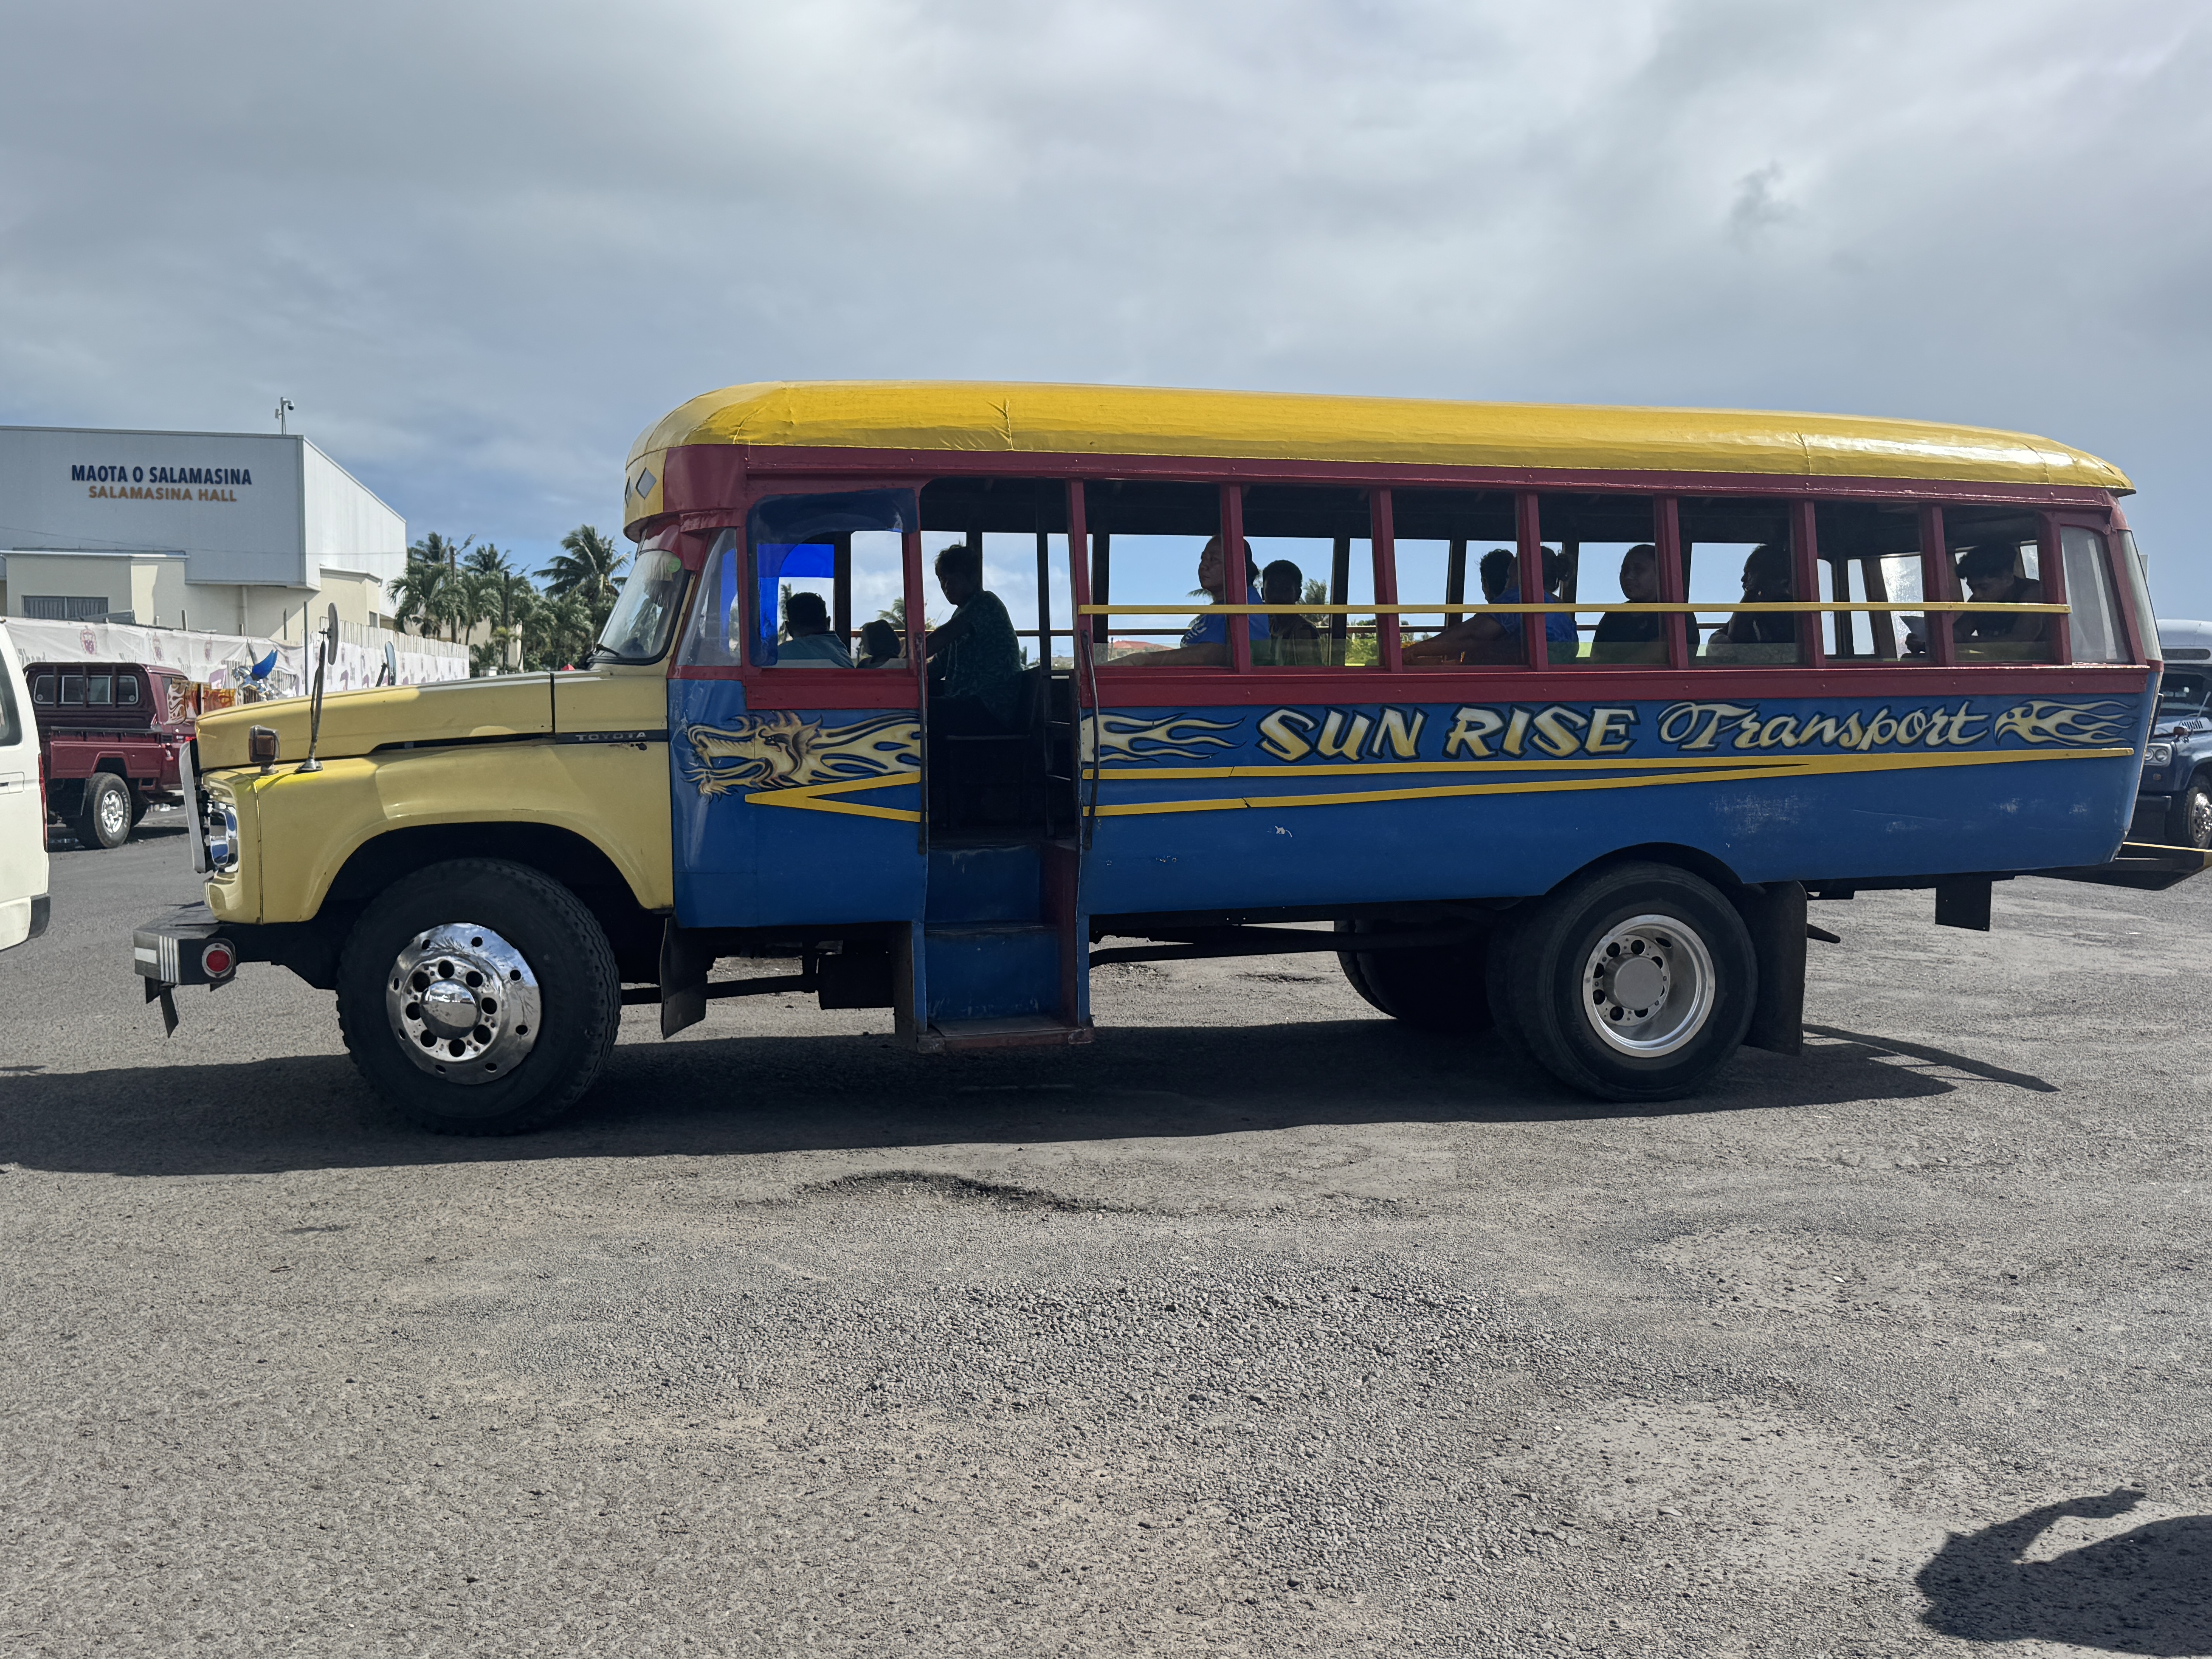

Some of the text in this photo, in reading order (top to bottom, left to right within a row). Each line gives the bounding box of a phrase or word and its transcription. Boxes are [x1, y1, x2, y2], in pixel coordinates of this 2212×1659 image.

[72, 465, 252, 485] MAOTA O SALAMASINA
[88, 486, 237, 502] SALAMASINA HALL
[575, 732, 646, 741] TOYOTA
[1255, 700, 1990, 763] SUN RISE Transport
